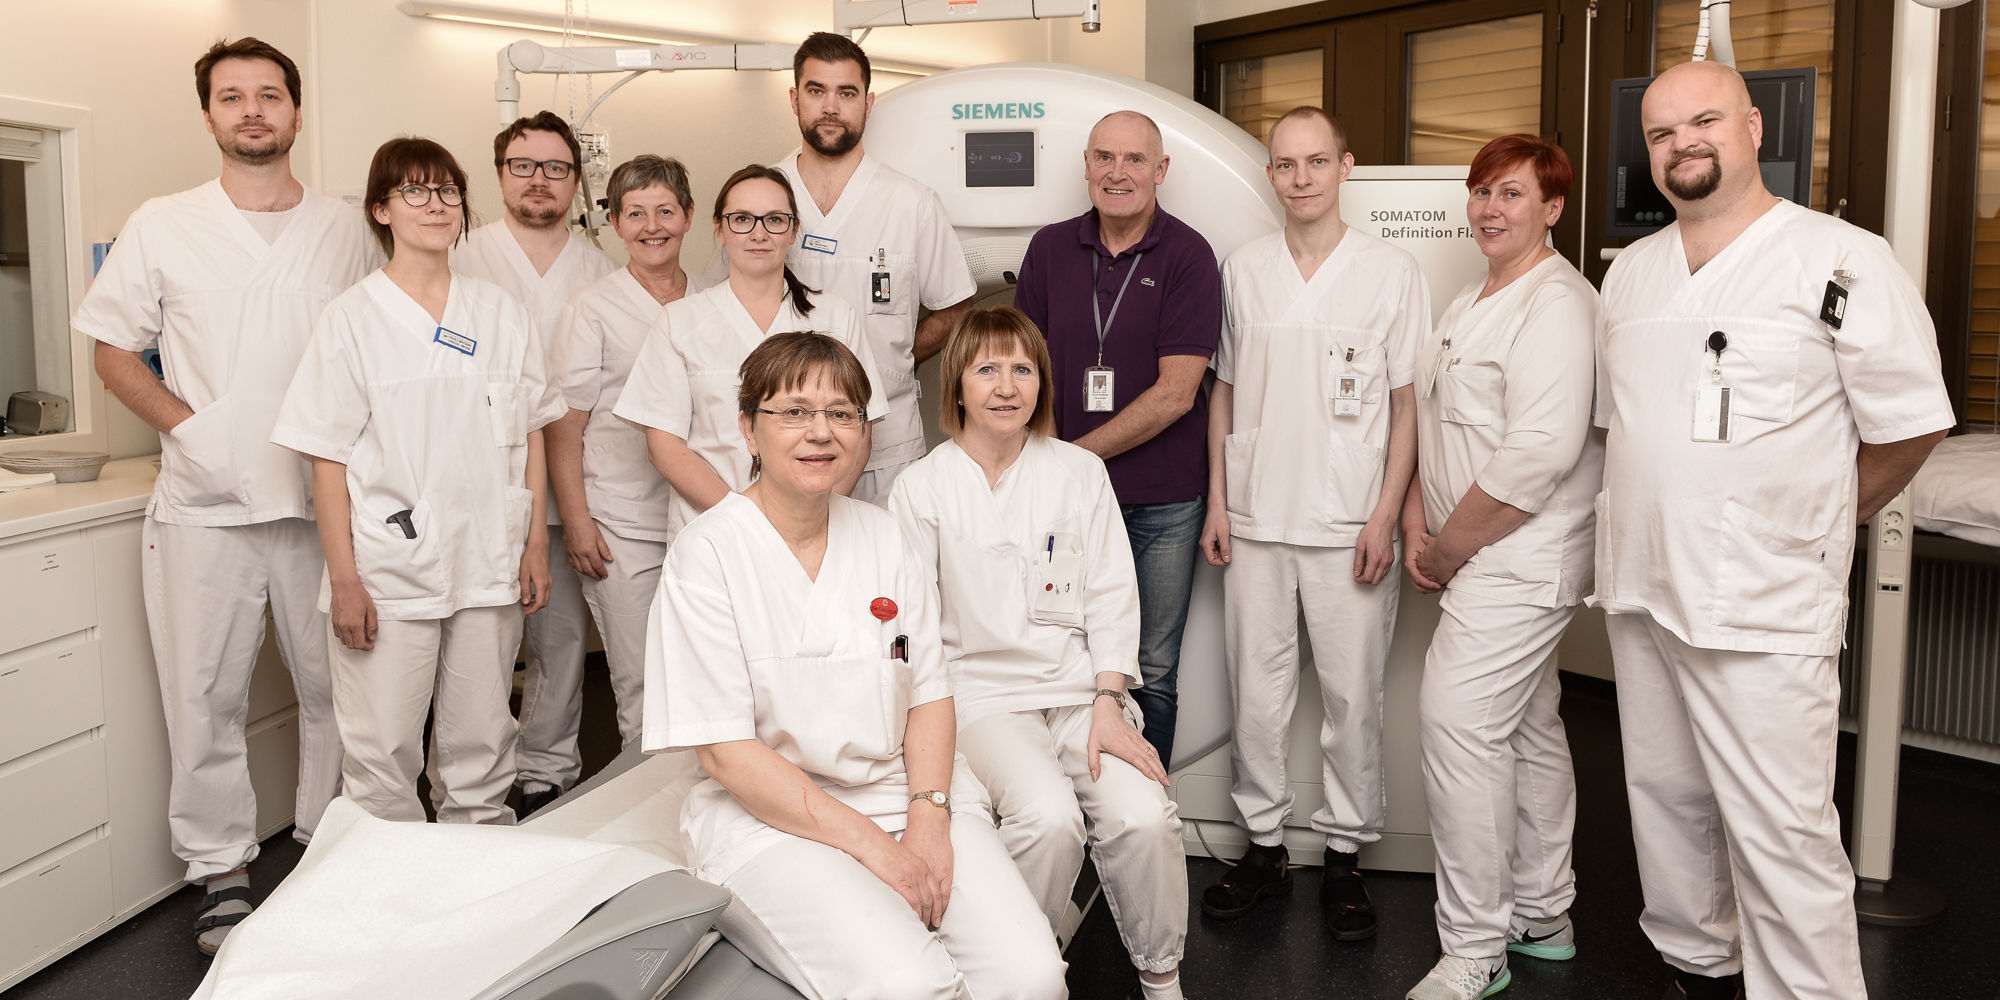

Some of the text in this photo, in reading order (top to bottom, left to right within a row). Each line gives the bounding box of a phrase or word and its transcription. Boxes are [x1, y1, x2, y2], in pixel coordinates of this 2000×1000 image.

[952, 102, 1045, 120] SIEMENS
[1370, 210, 1446, 222] SOMATOM
[1381, 226, 1453, 238] Definition
